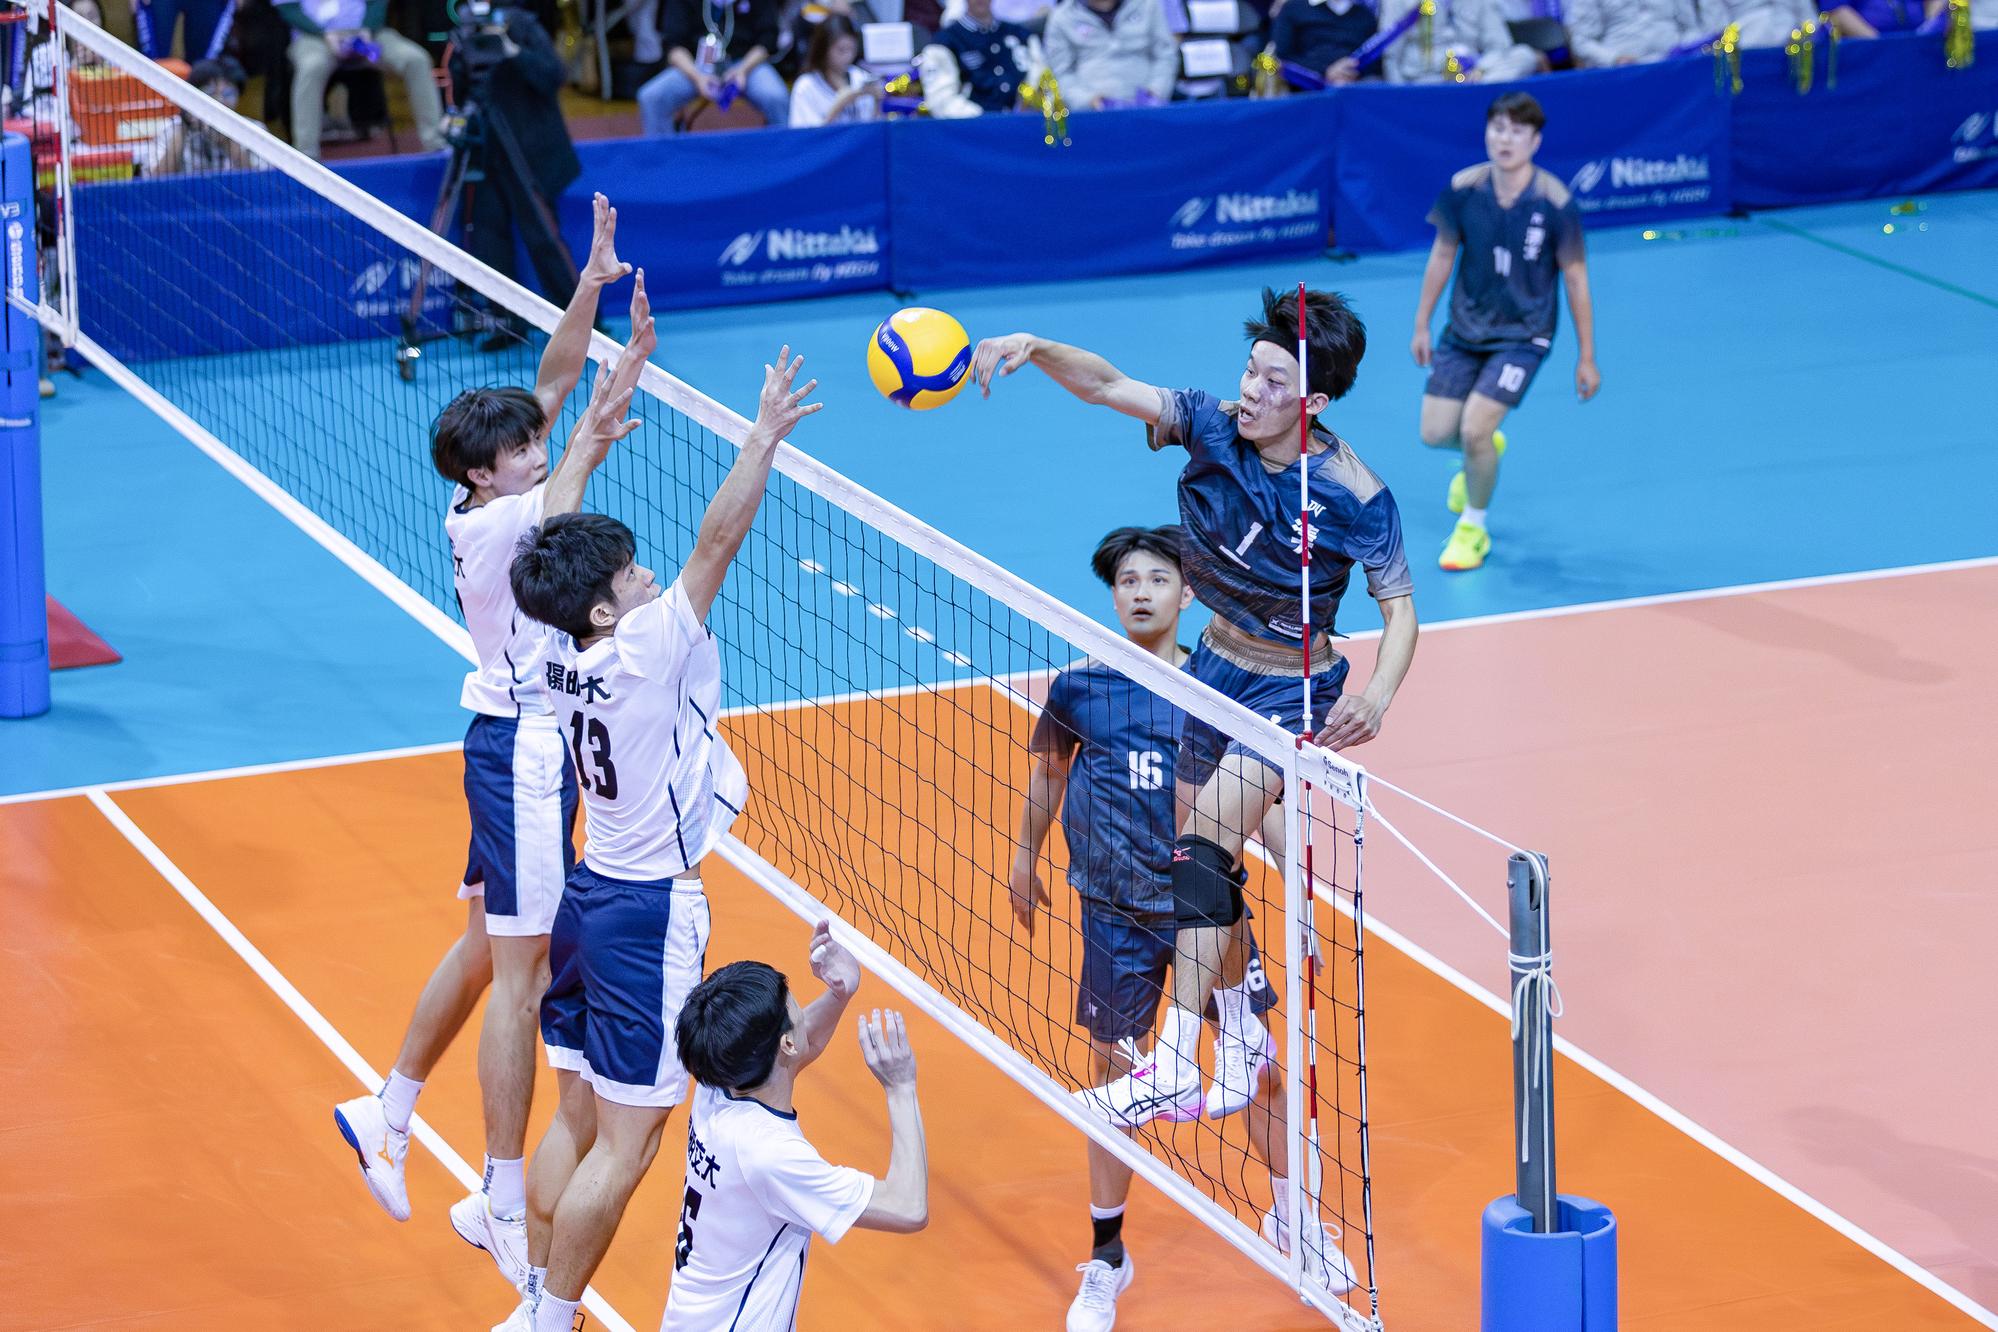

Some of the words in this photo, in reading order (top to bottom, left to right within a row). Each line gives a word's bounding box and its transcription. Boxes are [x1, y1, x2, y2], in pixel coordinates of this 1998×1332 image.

[1216, 189, 1320, 224] Nittaku
[767, 225, 879, 261] Nittaku
[1497, 363, 1526, 393] 10
[569, 710, 618, 800] 13
[1128, 750, 1163, 790] 16
[1327, 760, 1349, 777] Senoh
